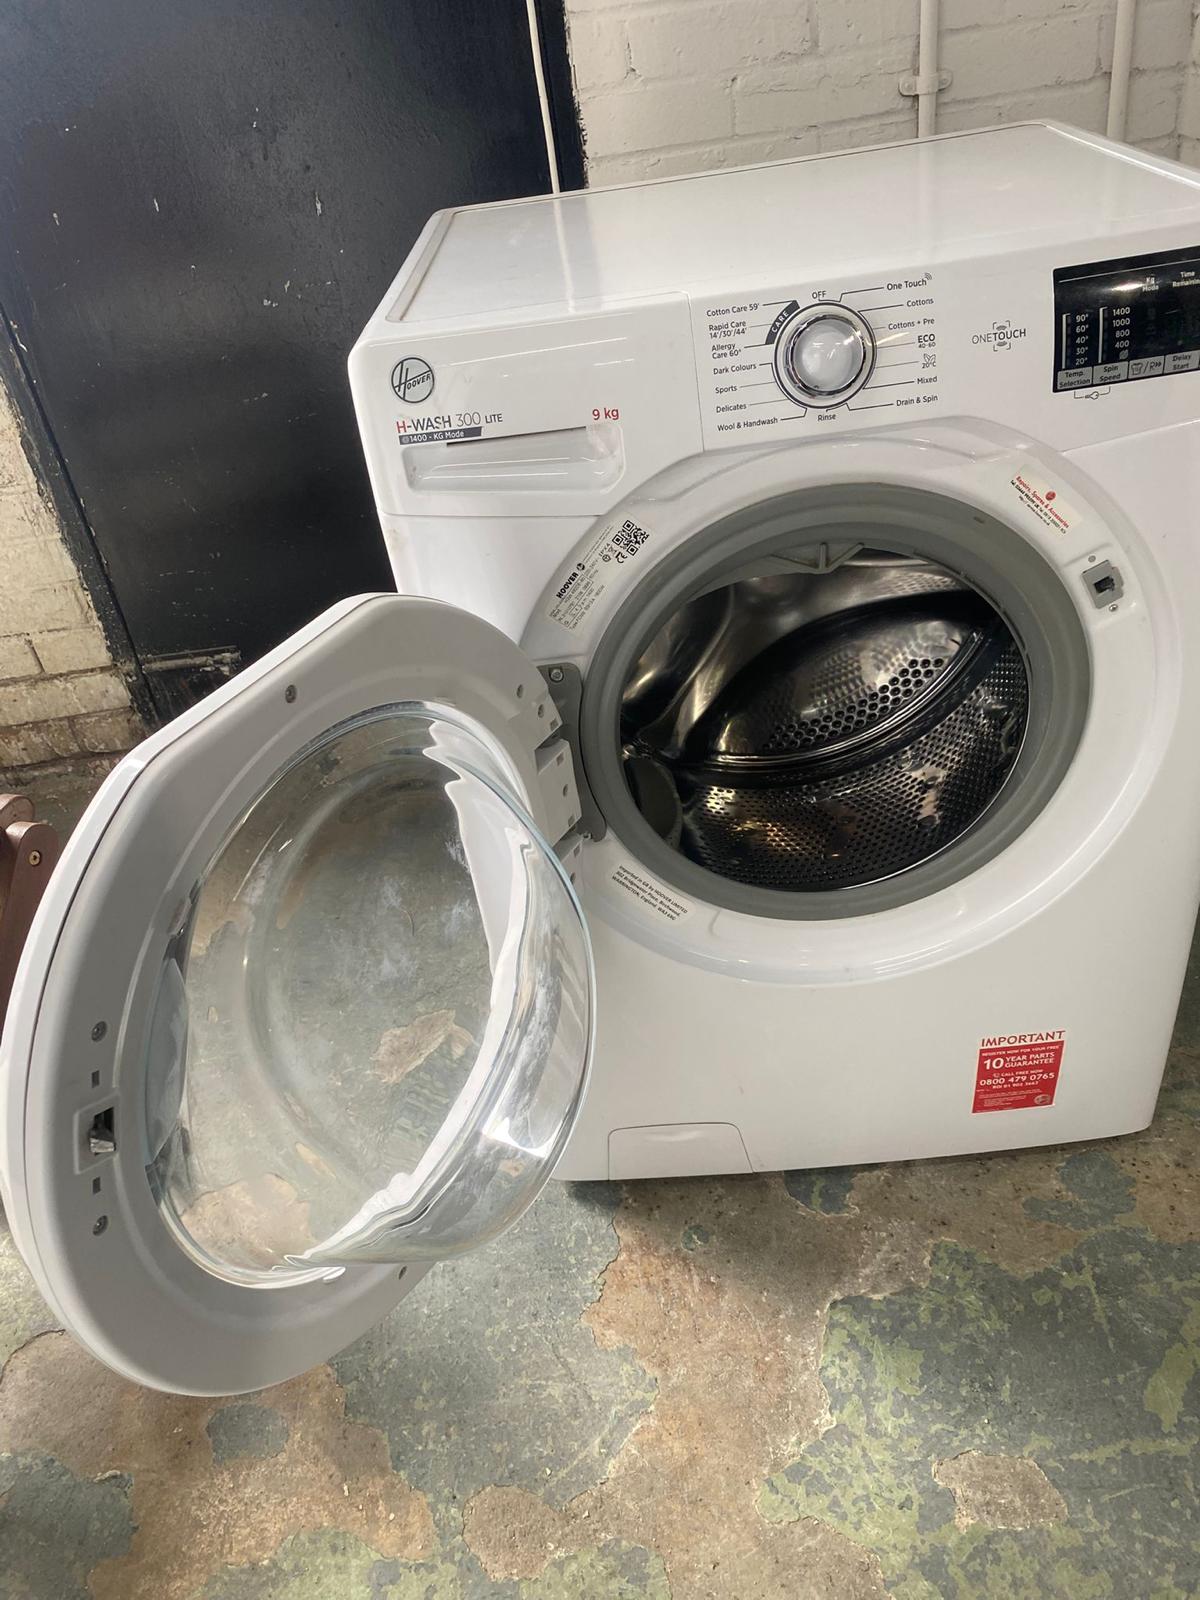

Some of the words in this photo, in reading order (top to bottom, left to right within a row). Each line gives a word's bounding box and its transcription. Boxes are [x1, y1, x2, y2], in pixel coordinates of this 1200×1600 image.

[886, 282, 902, 290] One
[904, 278, 927, 288] Touch
[812, 291, 827, 299] OFF
[906, 298, 934, 307] Cottons
[706, 308, 730, 318] Cotton
[732, 306, 747, 314] Care
[1113, 306, 1130, 316] 1400
[709, 322, 729, 332] Rapid
[730, 320, 746, 328] Care
[771, 311, 789, 333] CARE
[888, 320, 915, 330] Cottons
[1113, 317, 1130, 327] 1000
[1115, 328, 1130, 337] 800
[918, 333, 935, 343] ECO
[711, 343, 736, 352] Allergy
[1115, 340, 1130, 349] 400
[712, 351, 728, 360] Care
[1172, 354, 1191, 362] Delay
[713, 366, 729, 375] Dark
[730, 364, 757, 372] Colours
[1103, 365, 1118, 373] Spin
[917, 376, 938, 384] Mixed
[1100, 374, 1121, 382] Speed
[1059, 378, 1091, 389] Selection
[715, 385, 738, 394] Sports
[896, 398, 914, 407] Drain
[915, 396, 921, 404] &
[922, 394, 938, 403] Spin
[716, 403, 747, 413] Delicates
[591, 409, 601, 420] 9
[603, 407, 619, 420] kg
[817, 412, 836, 422] Rinse
[396, 415, 452, 434] H-WASH
[455, 411, 482, 426] 300
[485, 413, 503, 424] LITE
[717, 423, 735, 432] Wool
[743, 417, 778, 428] Handwash
[433, 432, 444, 440] KG
[445, 430, 464, 438] Mode
[1048, 507, 1069, 529] Accessories
[555, 571, 579, 599] HOOVER
[654, 889, 672, 902] HOOVER
[671, 900, 688, 914] LIMITED
[981, 1030, 1066, 1047] IMPORTANT
[983, 1057, 1005, 1070] 10
[1029, 1051, 1055, 1059] PARTS
[1004, 1058, 1055, 1068] GUARANTEE
[979, 1077, 1006, 1086] 0800
[1008, 1075, 1027, 1083] 479
[1029, 1072, 1055, 1081] 0765
